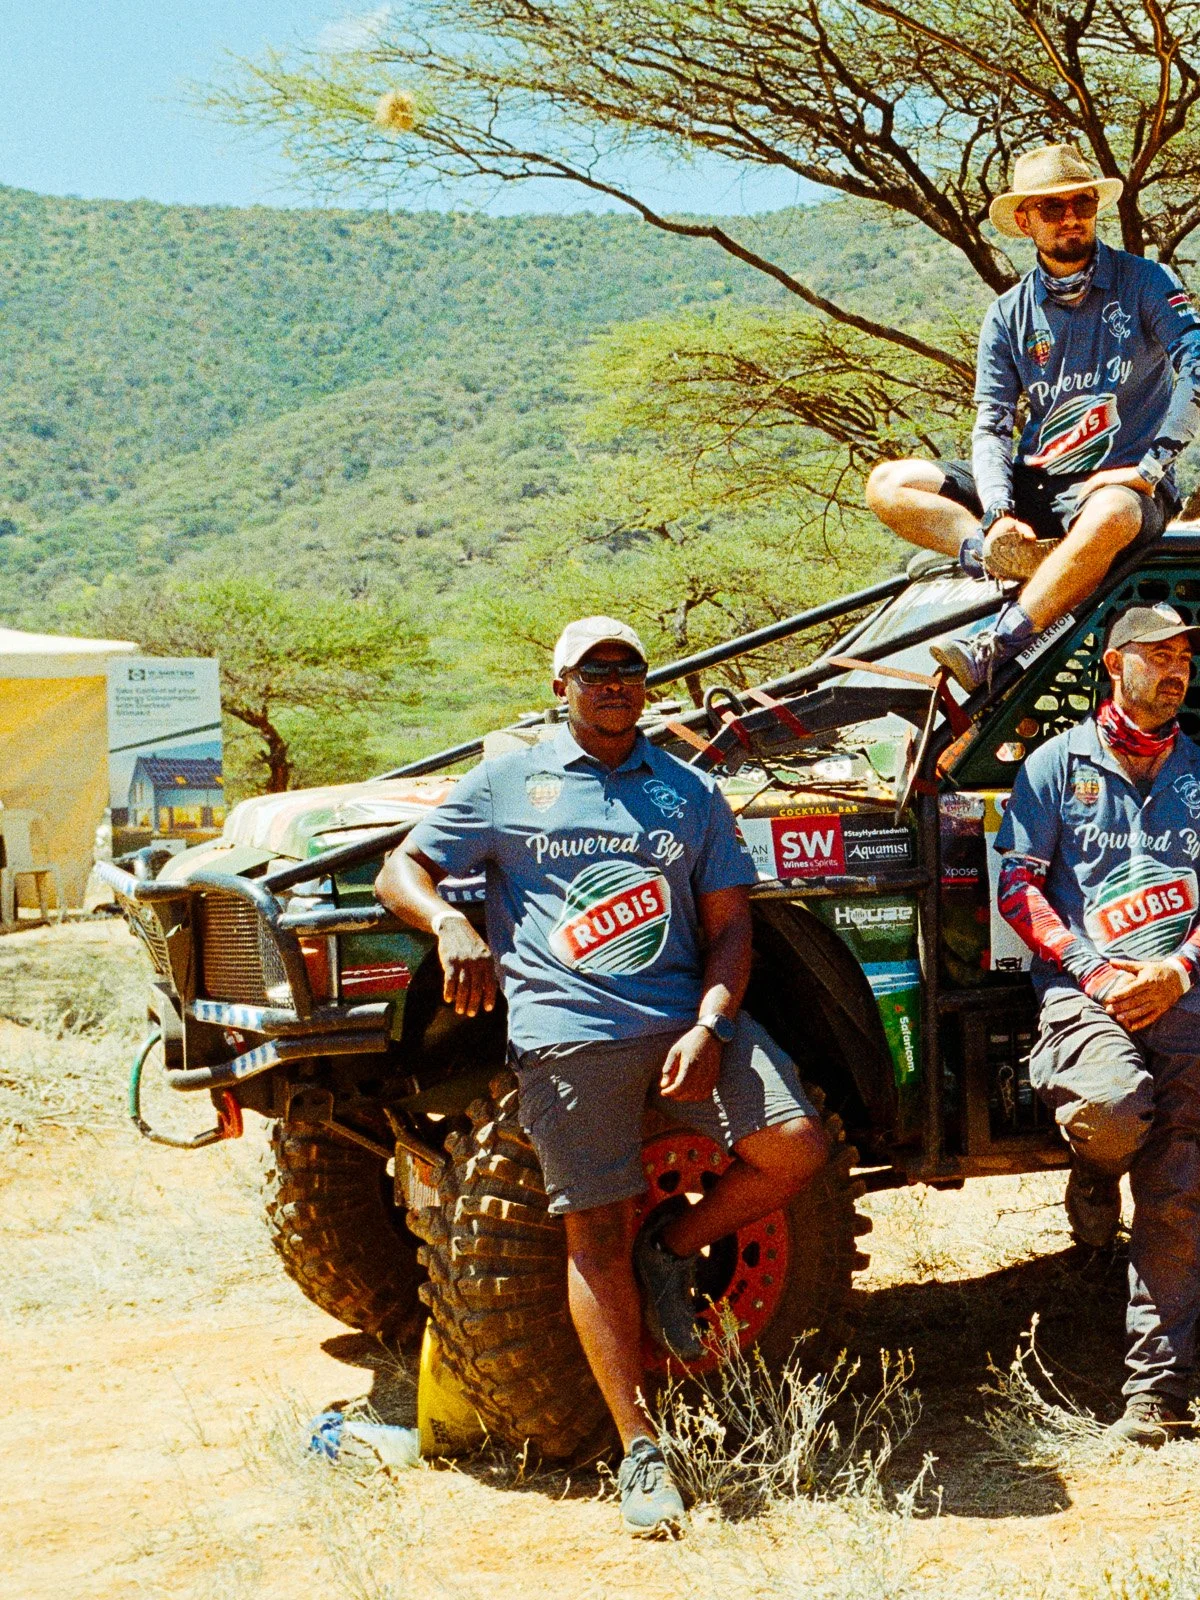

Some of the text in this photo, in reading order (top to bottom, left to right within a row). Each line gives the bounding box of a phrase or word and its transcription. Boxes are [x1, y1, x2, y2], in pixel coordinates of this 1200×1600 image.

[1029, 355, 1133, 406] Poered By
[779, 804, 859, 817] COCKTAIL BAR
[525, 829, 685, 867] Powered By
[780, 829, 835, 860] SW
[848, 843, 909, 860] Aquamist
[1074, 823, 1172, 852] Powered
[783, 860, 809, 869] Wines
